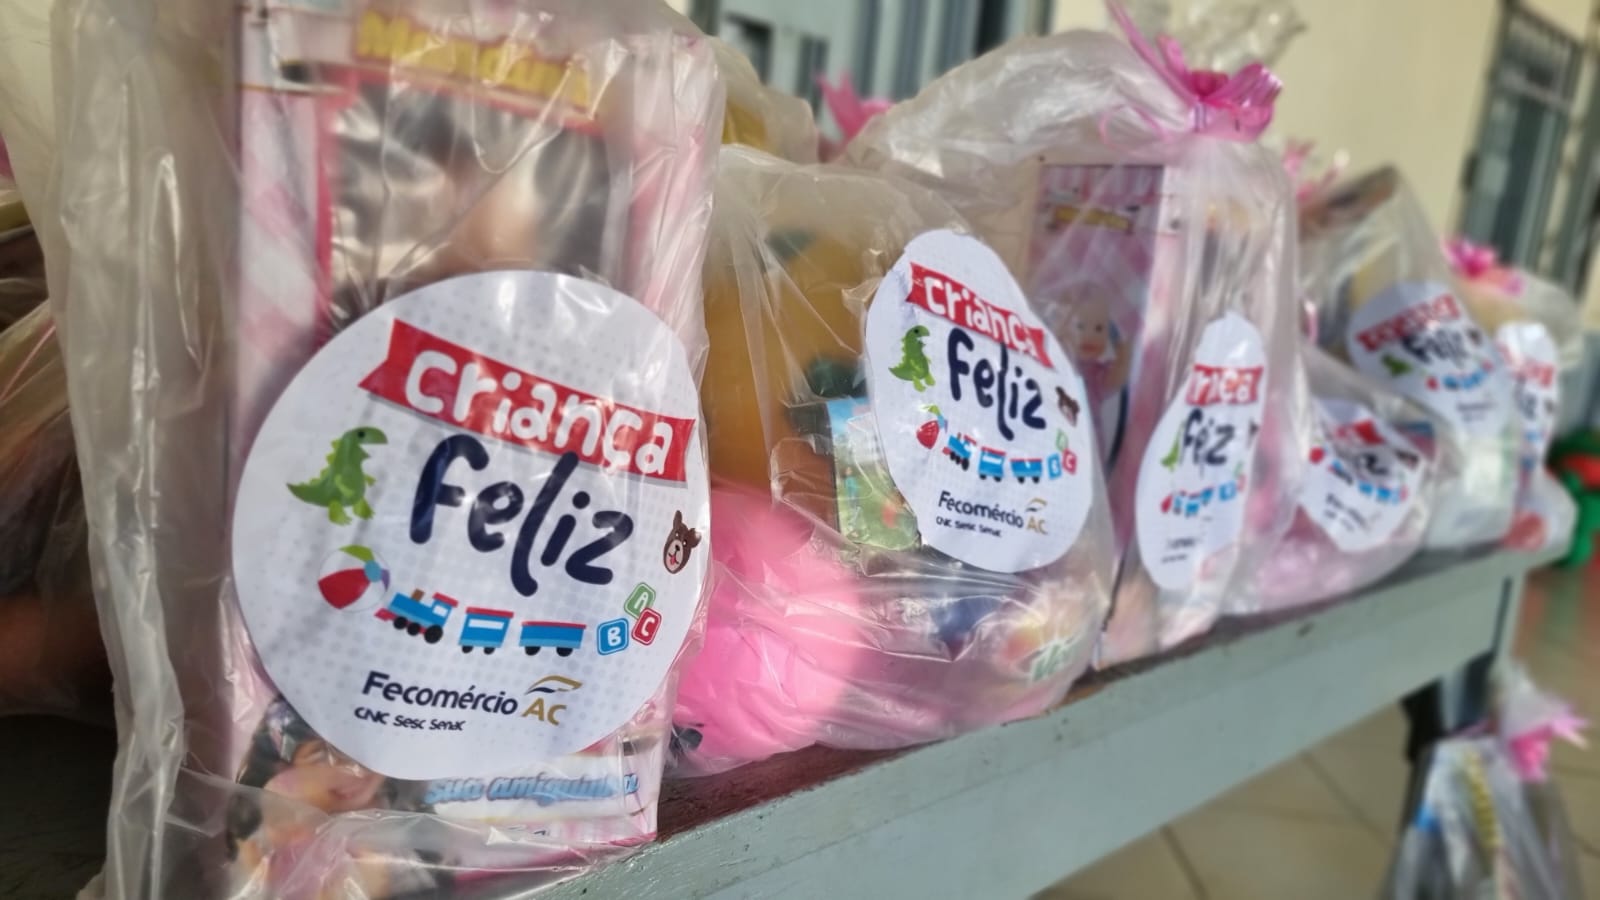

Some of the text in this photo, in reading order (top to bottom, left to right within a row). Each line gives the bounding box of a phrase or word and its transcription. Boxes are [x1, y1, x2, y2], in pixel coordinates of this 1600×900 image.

[404, 350, 674, 476] criança
[947, 327, 1047, 441] Feliz
[409, 433, 634, 597] Feliz
[938, 490, 1049, 535] Fecomércio AC
[362, 670, 567, 727] Fecomércio AC
